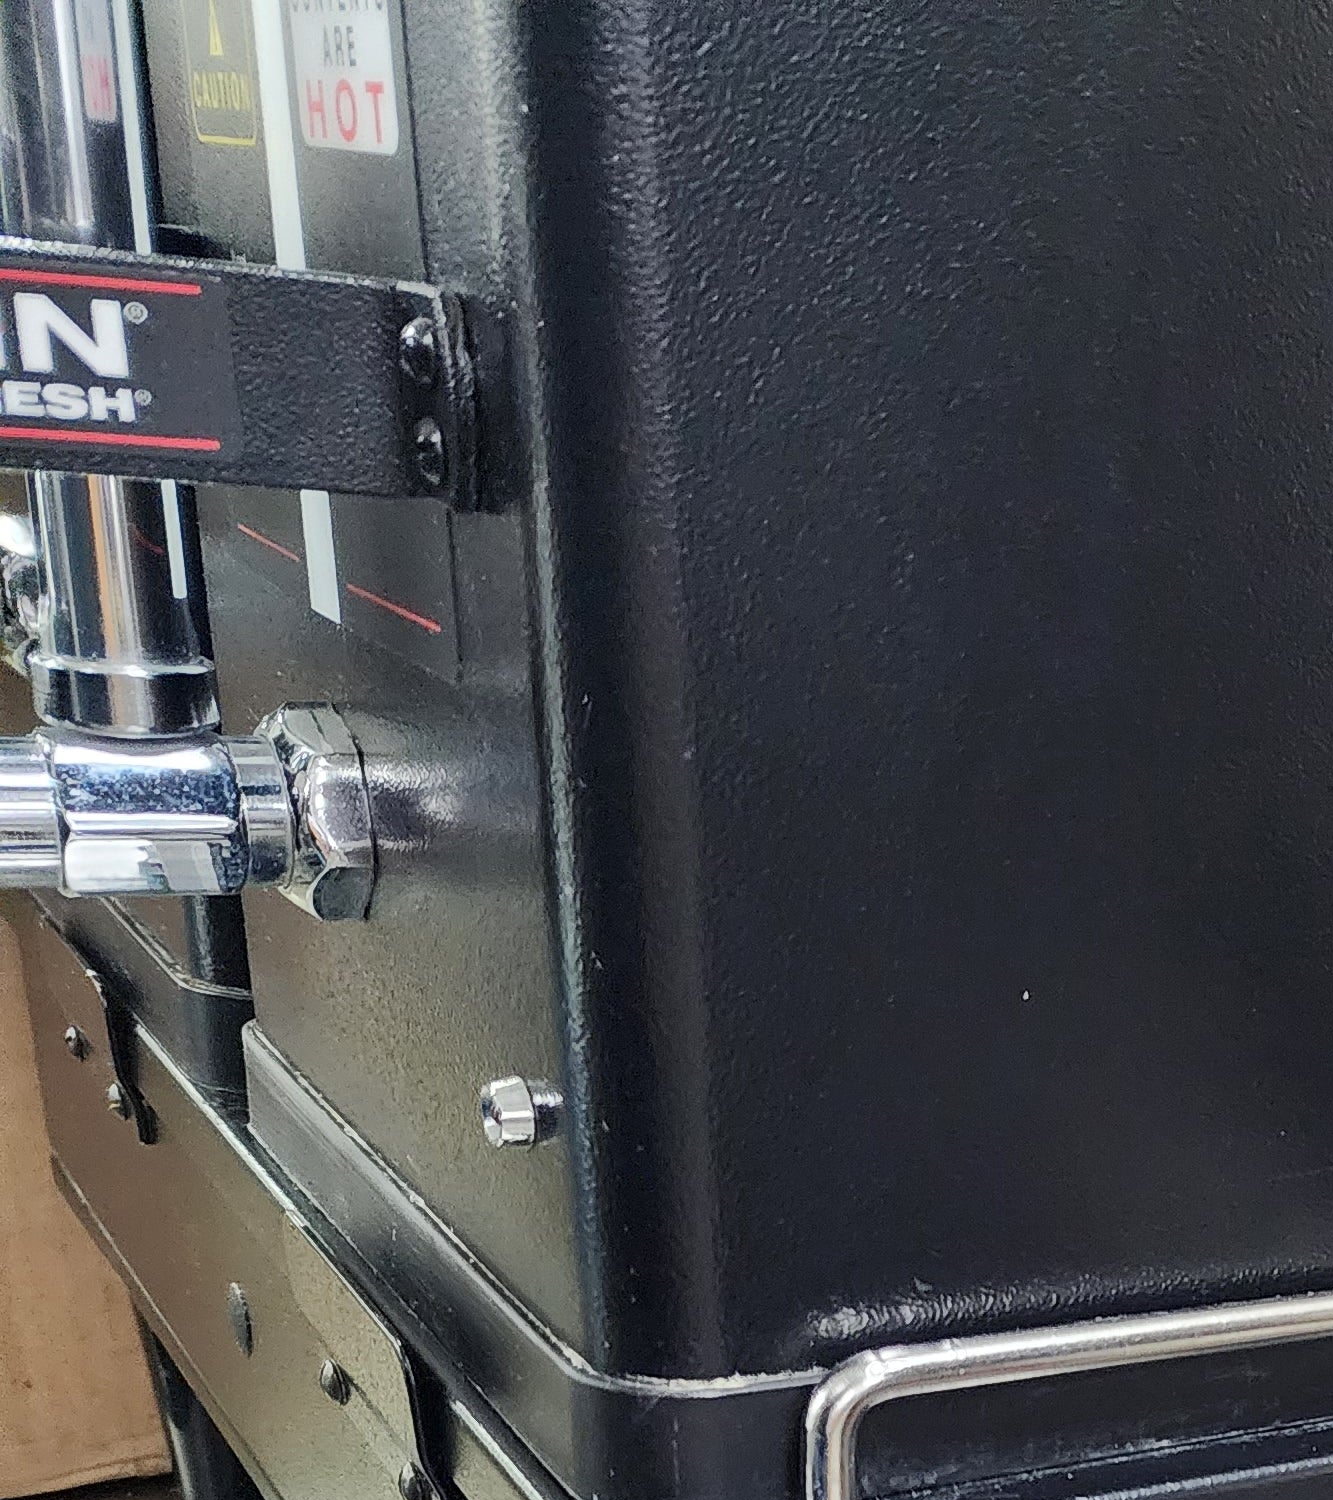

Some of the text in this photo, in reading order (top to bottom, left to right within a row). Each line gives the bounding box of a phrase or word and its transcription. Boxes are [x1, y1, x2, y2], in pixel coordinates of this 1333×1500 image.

[323, 25, 357, 67] ARE
[192, 70, 250, 111] CAUTION
[305, 78, 385, 144] HOT
[0, 291, 130, 379] N
[0, 379, 137, 423] ESH
